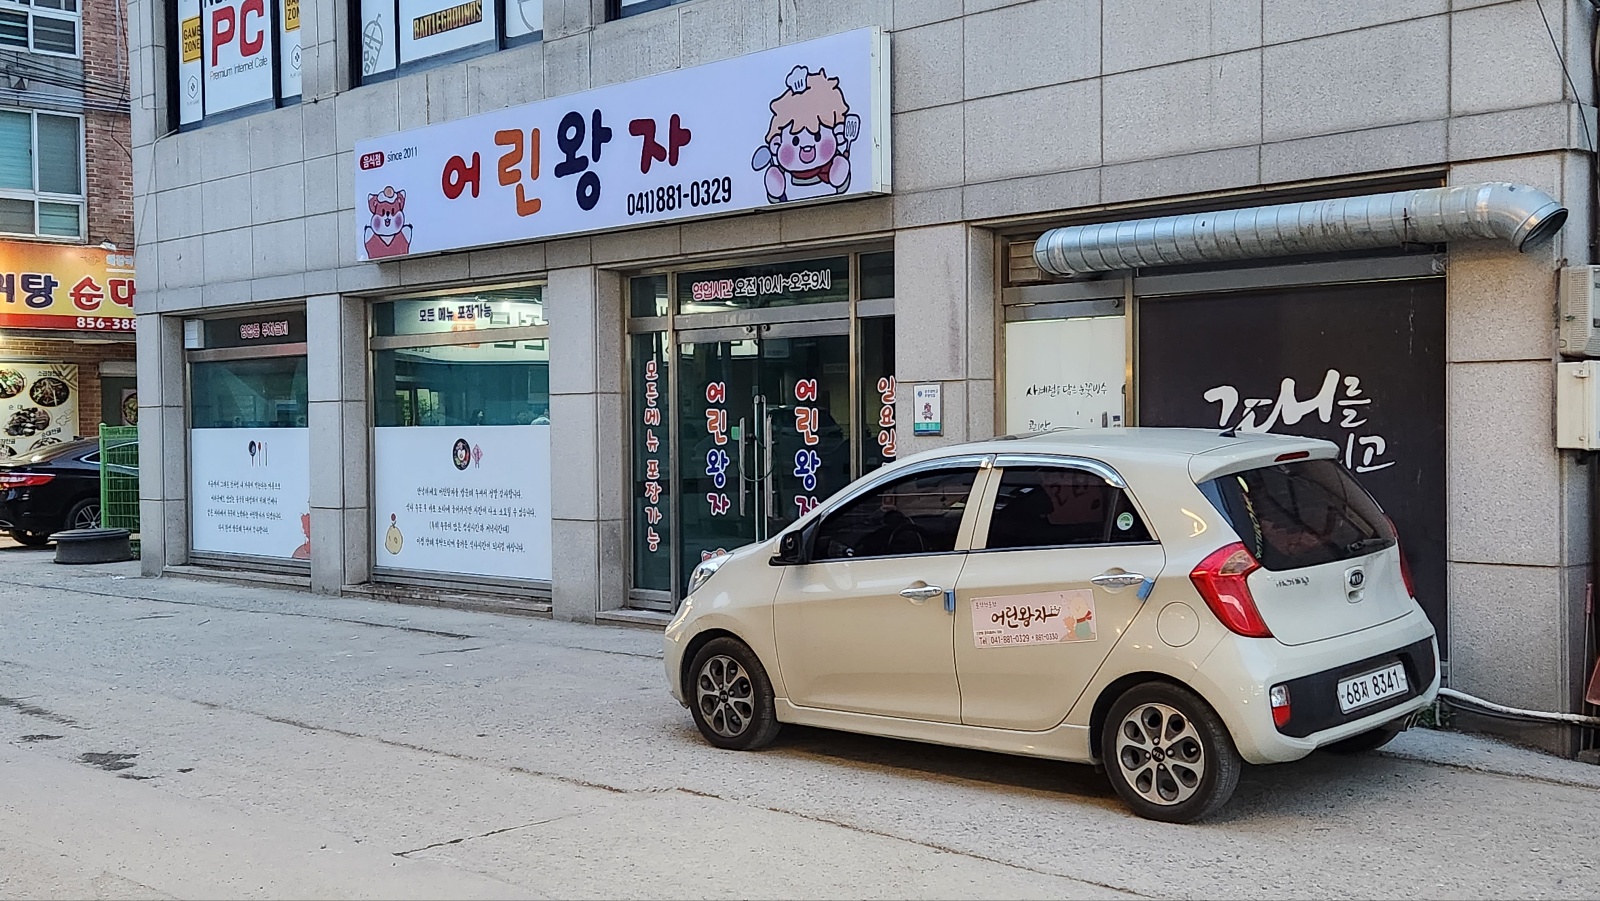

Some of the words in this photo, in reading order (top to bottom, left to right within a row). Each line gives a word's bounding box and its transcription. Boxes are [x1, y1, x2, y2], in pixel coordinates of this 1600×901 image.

[183, 25, 201, 40] GAME
[413, 1, 482, 40] BATTLEGROUNDS
[184, 38, 201, 53] ZONE
[212, 0, 264, 67] PC
[210, 68, 233, 80] Premium
[255, 56, 268, 69] Cafe
[363, 153, 381, 169] 음식점
[387, 150, 402, 162] since
[403, 146, 418, 159] 2011
[442, 109, 692, 217] 어린왕자
[626, 176, 733, 217] 041)881-0329
[692, 280, 734, 301] 영업시간
[734, 277, 757, 297] 오전
[419, 309, 435, 322] 모든
[438, 307, 454, 321] 메뉴
[457, 303, 492, 319] 포장가능
[240, 323, 260, 339] 영업중
[261, 320, 289, 338] 주차금지
[705, 381, 731, 517] 어린왕자
[793, 378, 822, 519] 어린왕자
[991, 606, 1059, 629] 어린왕자
[990, 633, 1030, 645] 041-881-0329
[1372, 668, 1400, 696] 8341
